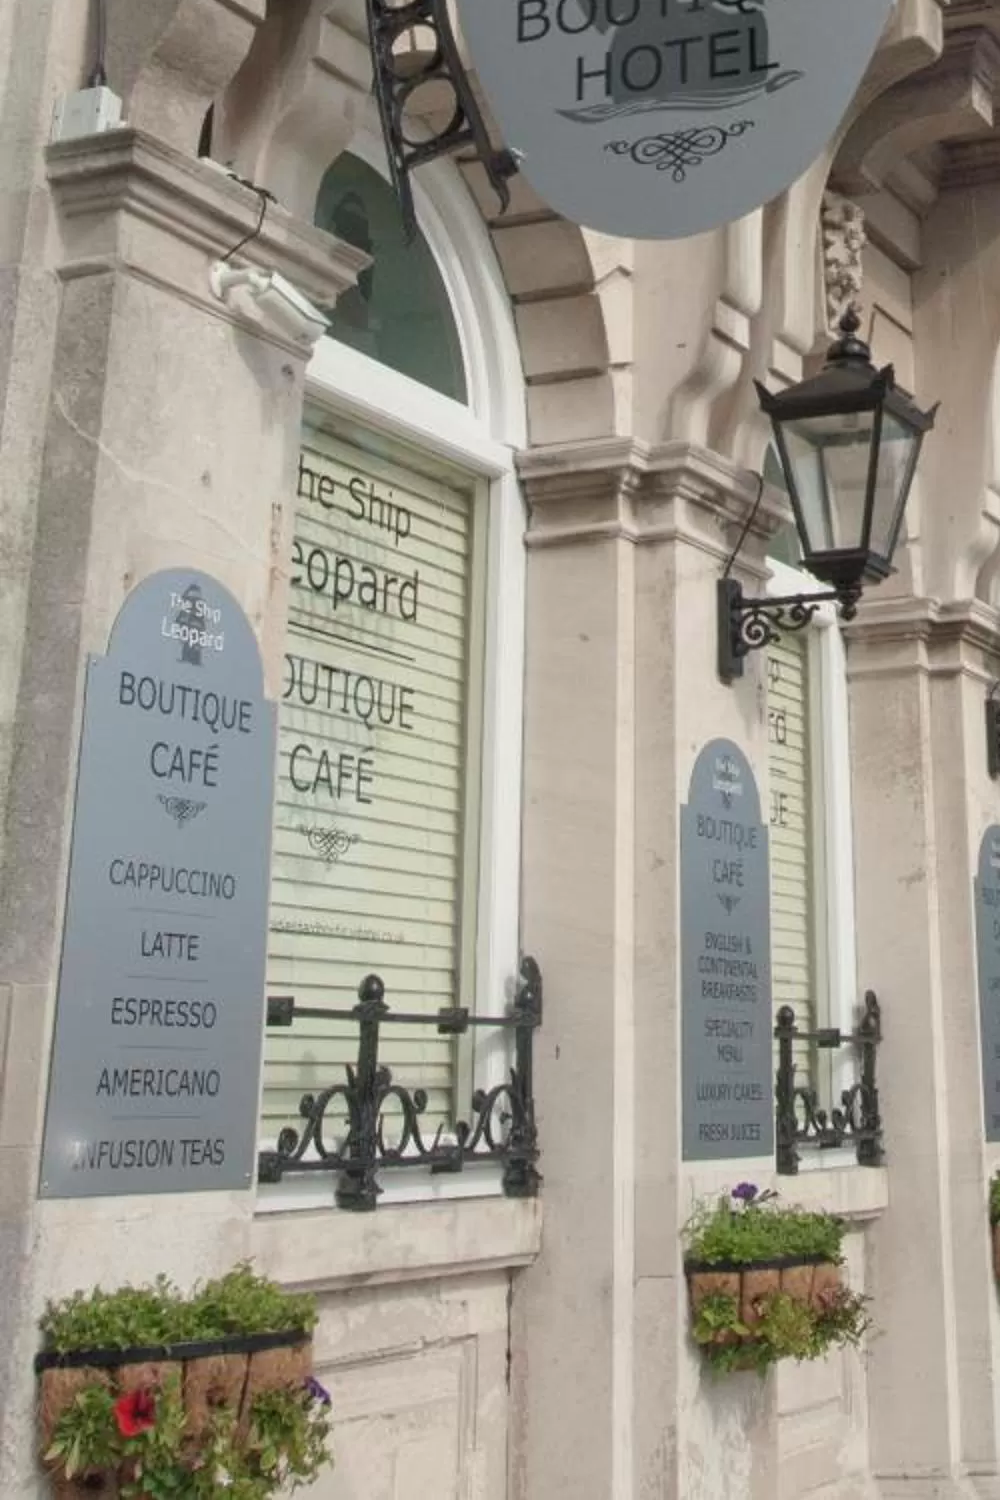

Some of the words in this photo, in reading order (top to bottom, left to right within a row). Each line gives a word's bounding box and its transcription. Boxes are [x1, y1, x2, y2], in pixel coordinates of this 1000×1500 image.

[574, 25, 780, 102] HOTEL
[296, 453, 335, 510] he
[348, 476, 412, 548] Ship
[289, 538, 420, 624] eopard
[169, 592, 192, 613] The
[195, 599, 222, 625] Ship
[160, 615, 225, 652] Leopard
[118, 670, 253, 735] BOUTIQUE
[282, 653, 416, 731] UTIQUE
[150, 741, 220, 788] CAFÉ
[288, 742, 375, 805] CAFÉ
[696, 812, 758, 853] BOUTIQUE
[108, 858, 237, 900] CAPPUCCINO
[140, 930, 199, 961] LATTE
[110, 996, 218, 1029] ESPRESSO
[95, 1066, 221, 1098] AMERICANO
[179, 1137, 225, 1166] TEAS
